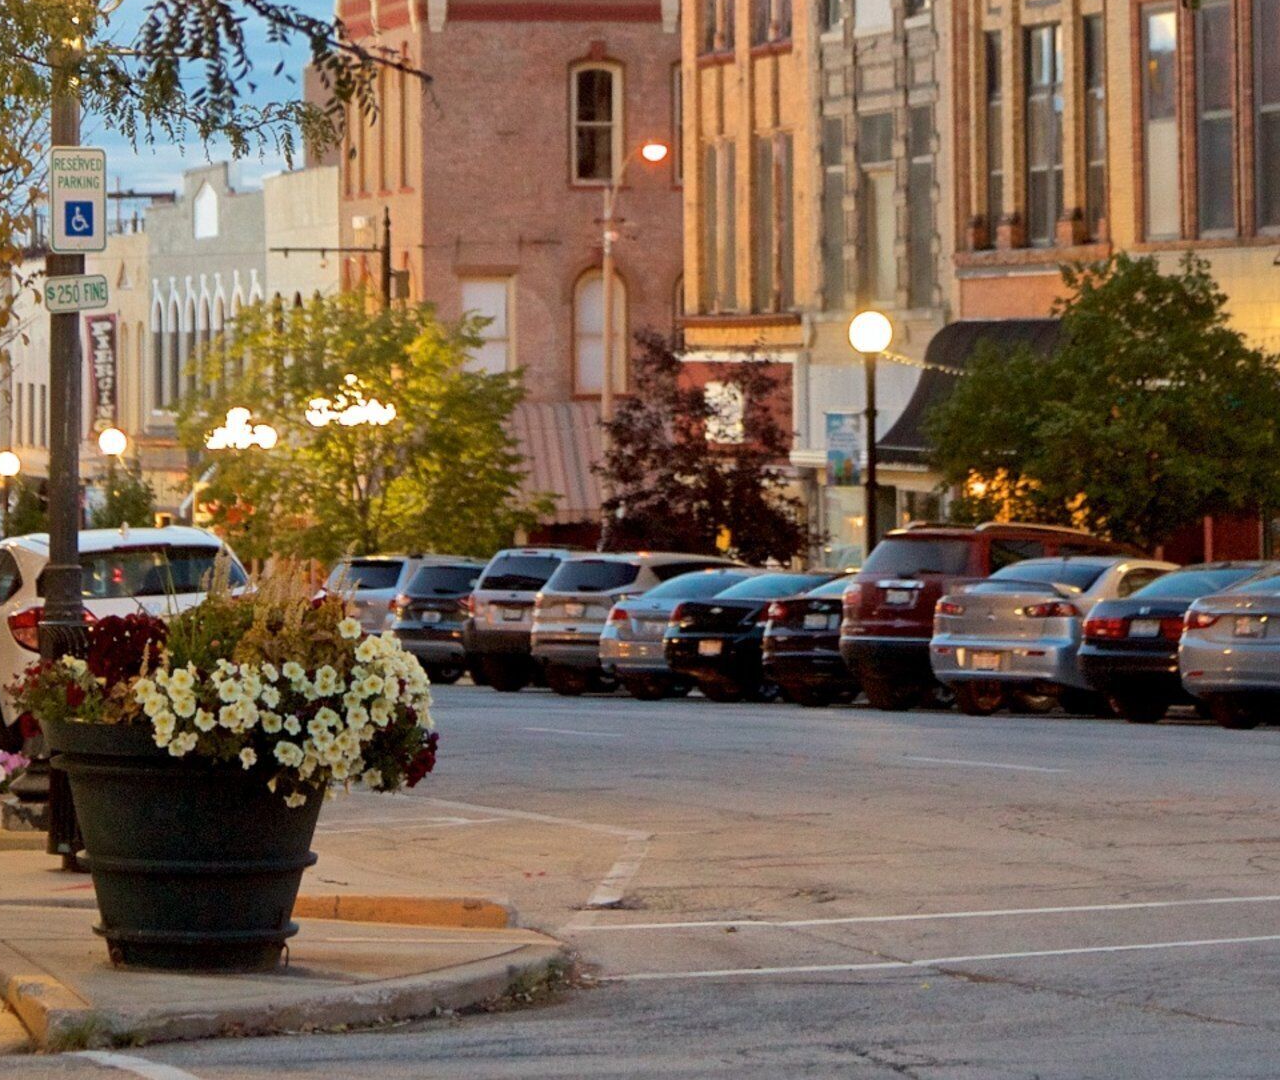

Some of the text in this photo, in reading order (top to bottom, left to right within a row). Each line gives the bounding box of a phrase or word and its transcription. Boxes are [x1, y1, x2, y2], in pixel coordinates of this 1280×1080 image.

[53, 157, 103, 172] RESERVED
[57, 176, 100, 189] PARKING
[84, 282, 106, 302] FINE
[91, 320, 115, 434] PIERCING
